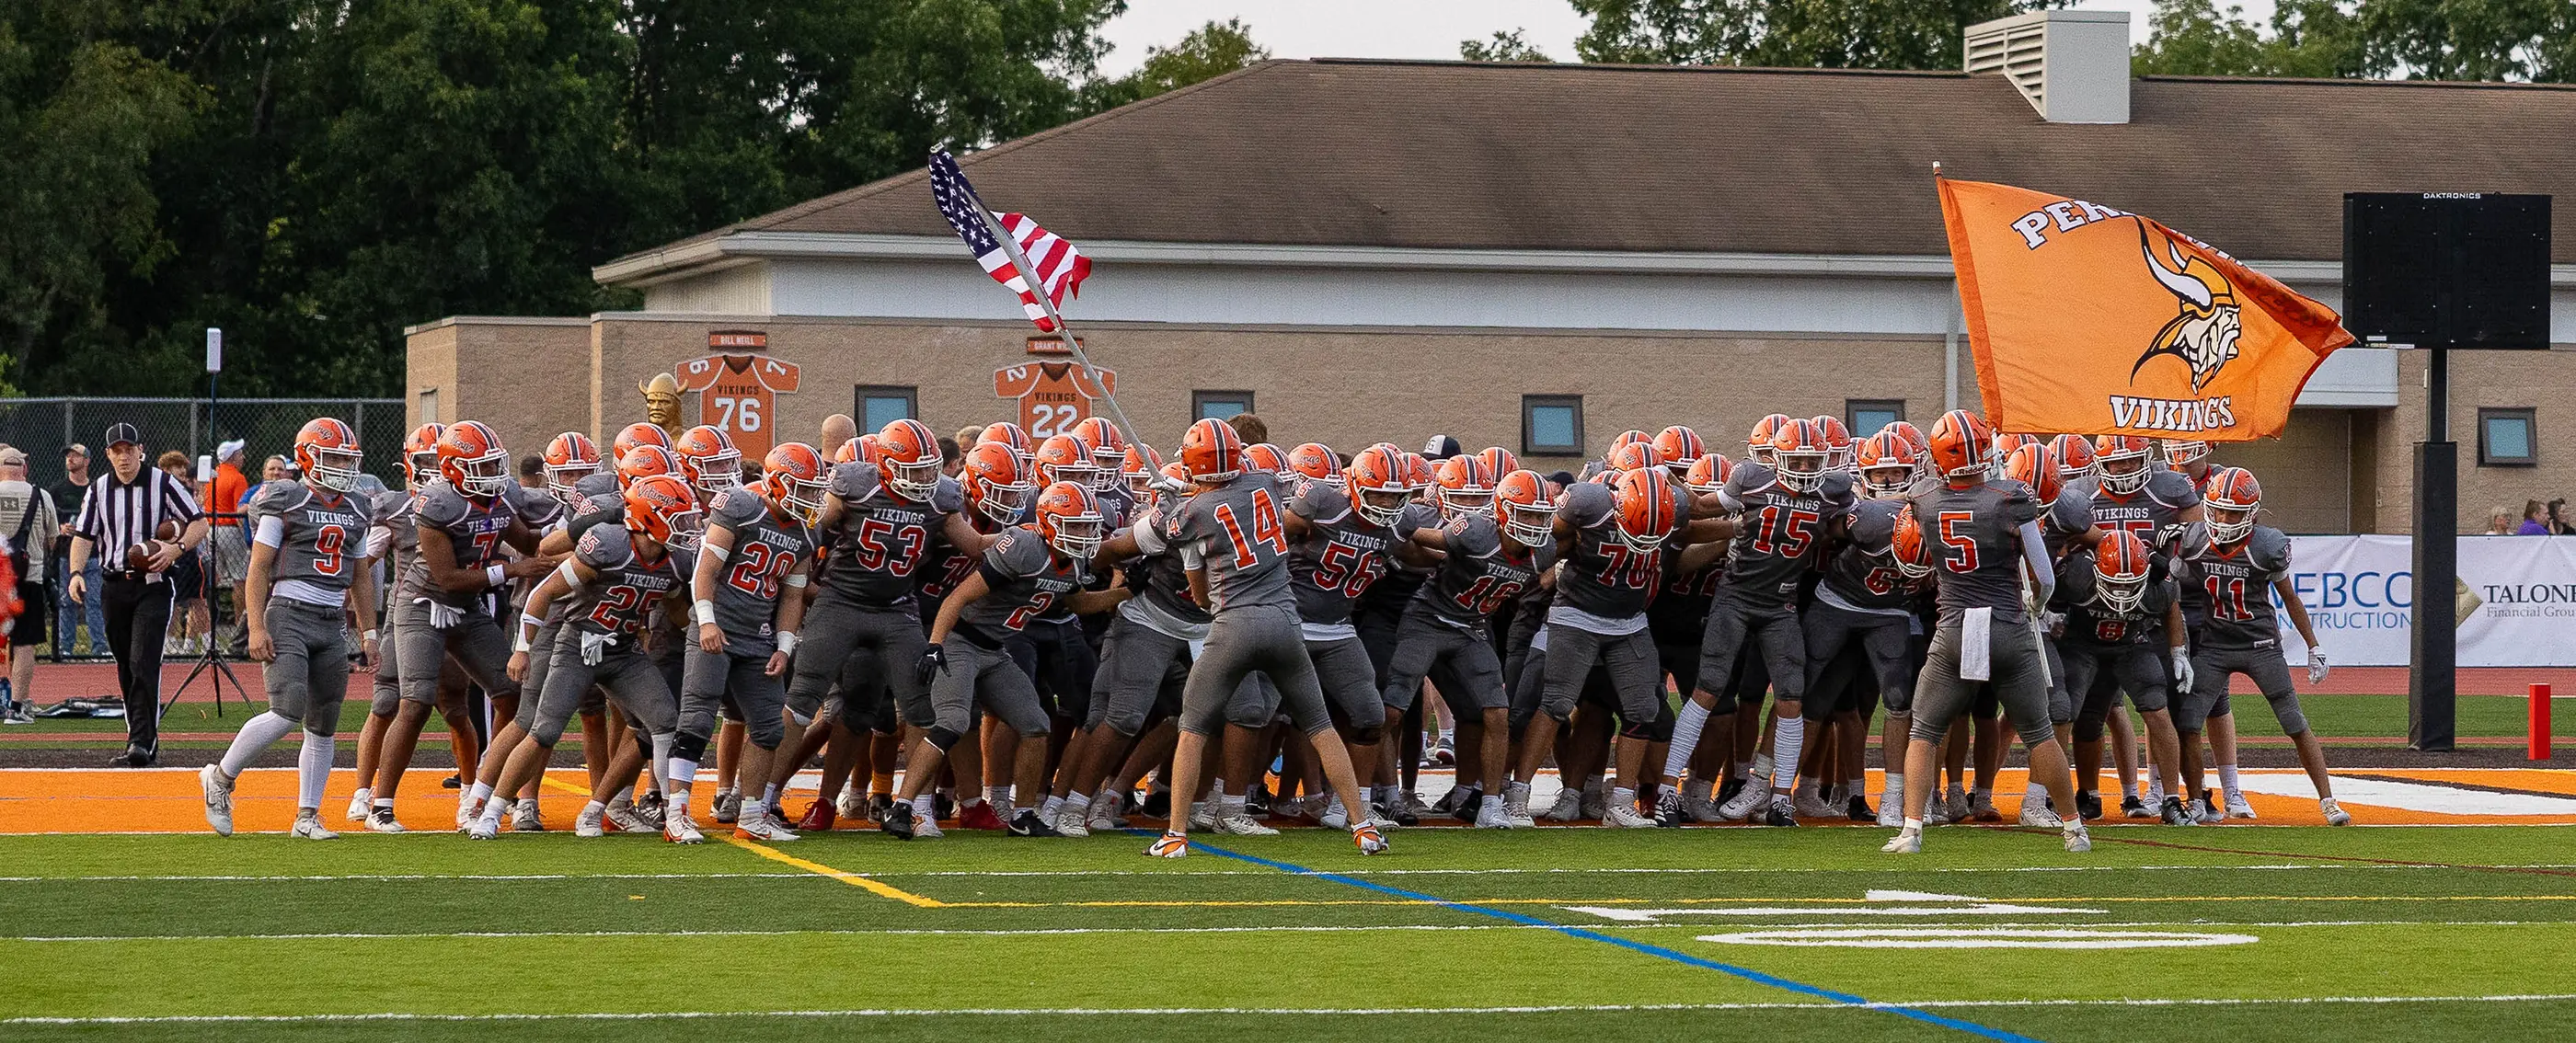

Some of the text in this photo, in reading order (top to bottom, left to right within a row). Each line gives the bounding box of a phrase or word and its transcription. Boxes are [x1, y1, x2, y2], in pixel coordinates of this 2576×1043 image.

[720, 335, 754, 346] BILL NEILL
[717, 385, 759, 395] VIKINGS
[1034, 392, 1077, 402] VIKINGS
[715, 397, 762, 432] 76
[1032, 405, 1078, 439] 22
[2110, 395, 2237, 432] VIKINGS
[1205, 472, 1236, 483] Riddell
[1958, 464, 1987, 476] Riddell
[415, 496, 429, 514] 7
[1765, 493, 1821, 511] VIKINGS
[306, 510, 355, 526] VIKINGS
[873, 508, 926, 524] VIKINGS
[2096, 507, 2149, 520] VIKINGS
[1213, 487, 1288, 570] 14
[1752, 505, 1821, 559] 15
[759, 527, 802, 552] VIKINGS
[856, 517, 927, 578] 53
[996, 535, 1015, 554] 2
[1938, 510, 1980, 574] 5
[314, 524, 346, 577] 9
[466, 531, 499, 571] 7
[728, 541, 798, 600] 20
[1312, 540, 1386, 599] 56
[1487, 562, 1531, 582] VIKINGS
[2202, 562, 2250, 578] VIKINGS
[624, 572, 671, 590] VIKINGS
[1036, 578, 1074, 593] VIKINGS
[1454, 575, 1524, 614] 16
[2204, 575, 2254, 623] 11
[1004, 593, 1054, 631] 2
[2487, 606, 2540, 618] Financial
[2096, 618, 2128, 641] 8
